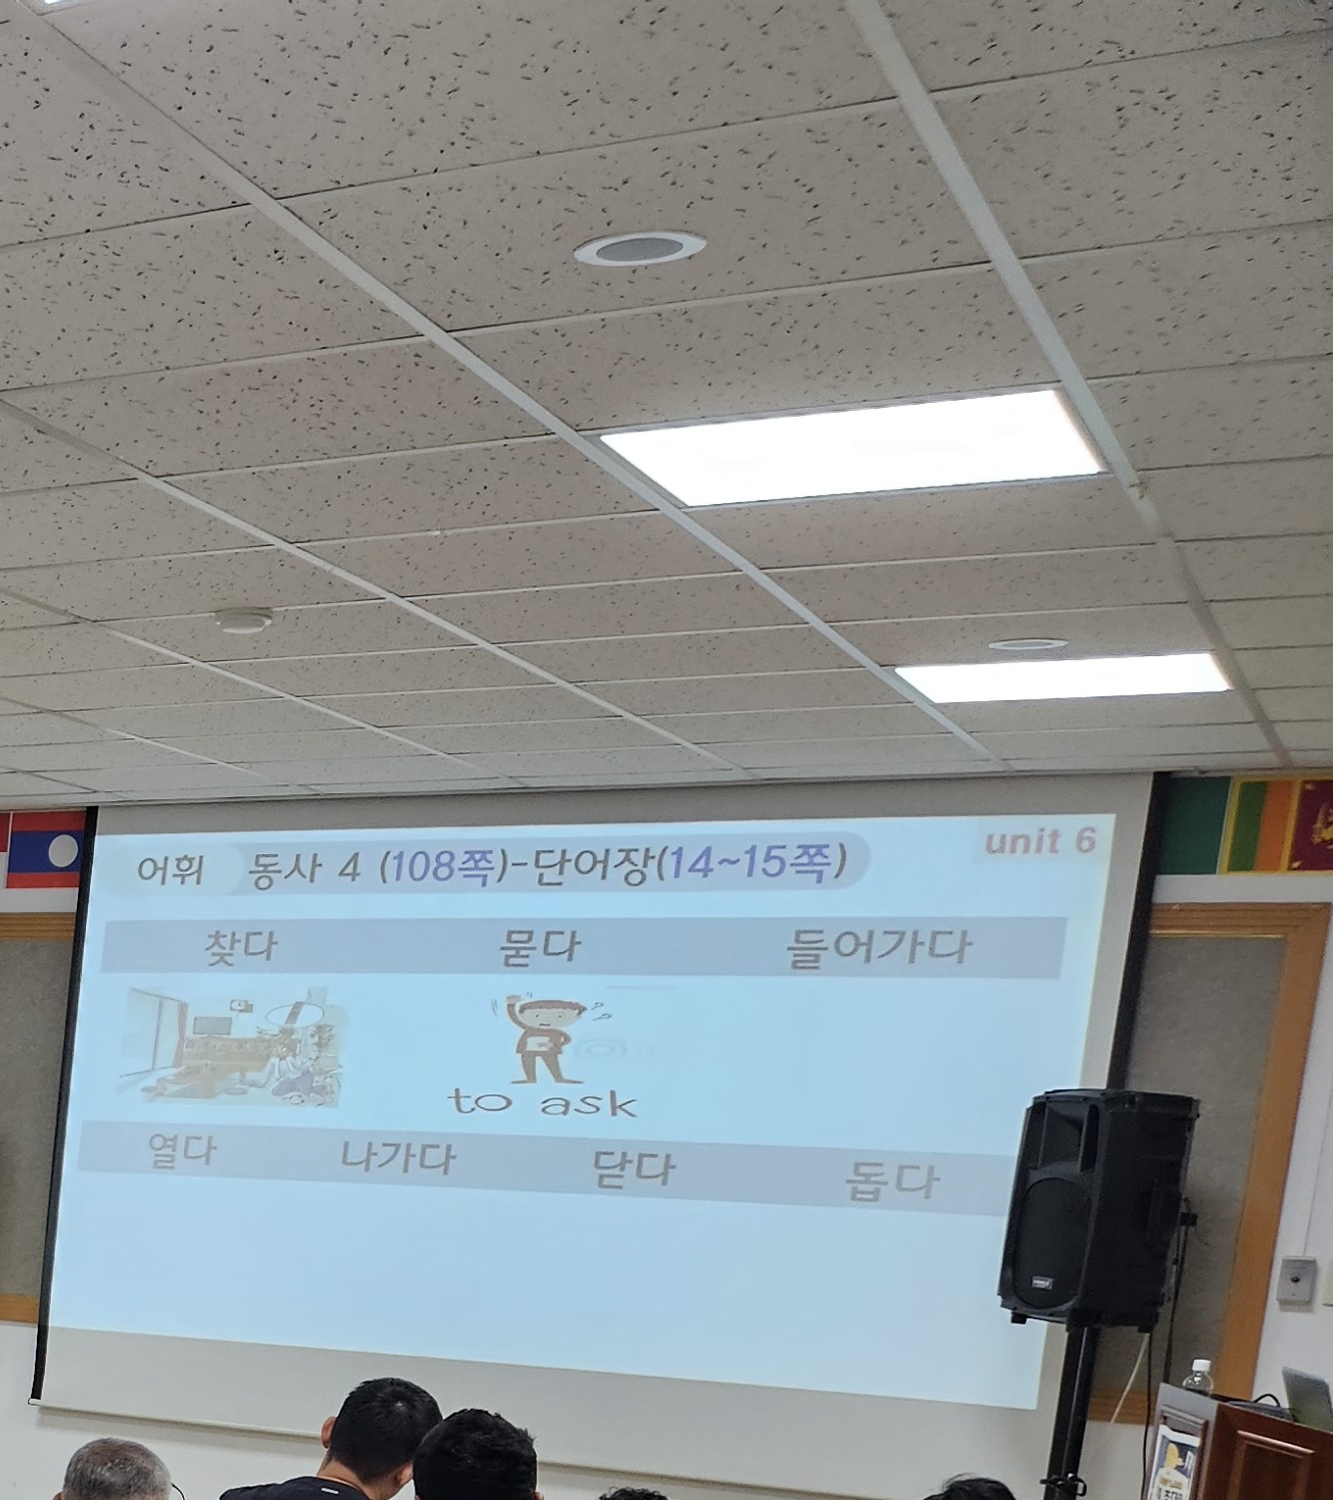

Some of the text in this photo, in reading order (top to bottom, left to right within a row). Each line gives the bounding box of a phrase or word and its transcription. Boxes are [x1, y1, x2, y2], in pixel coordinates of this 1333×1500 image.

[985, 826, 1098, 855] unit 6
[137, 854, 204, 886] 어휘
[248, 852, 322, 891] 동사
[338, 851, 362, 882] 4
[205, 929, 974, 970] 찾다 묻다 들어가다
[447, 1087, 638, 1117] to ask
[148, 1133, 942, 1203] 열다 나가다 닫다 돕다
